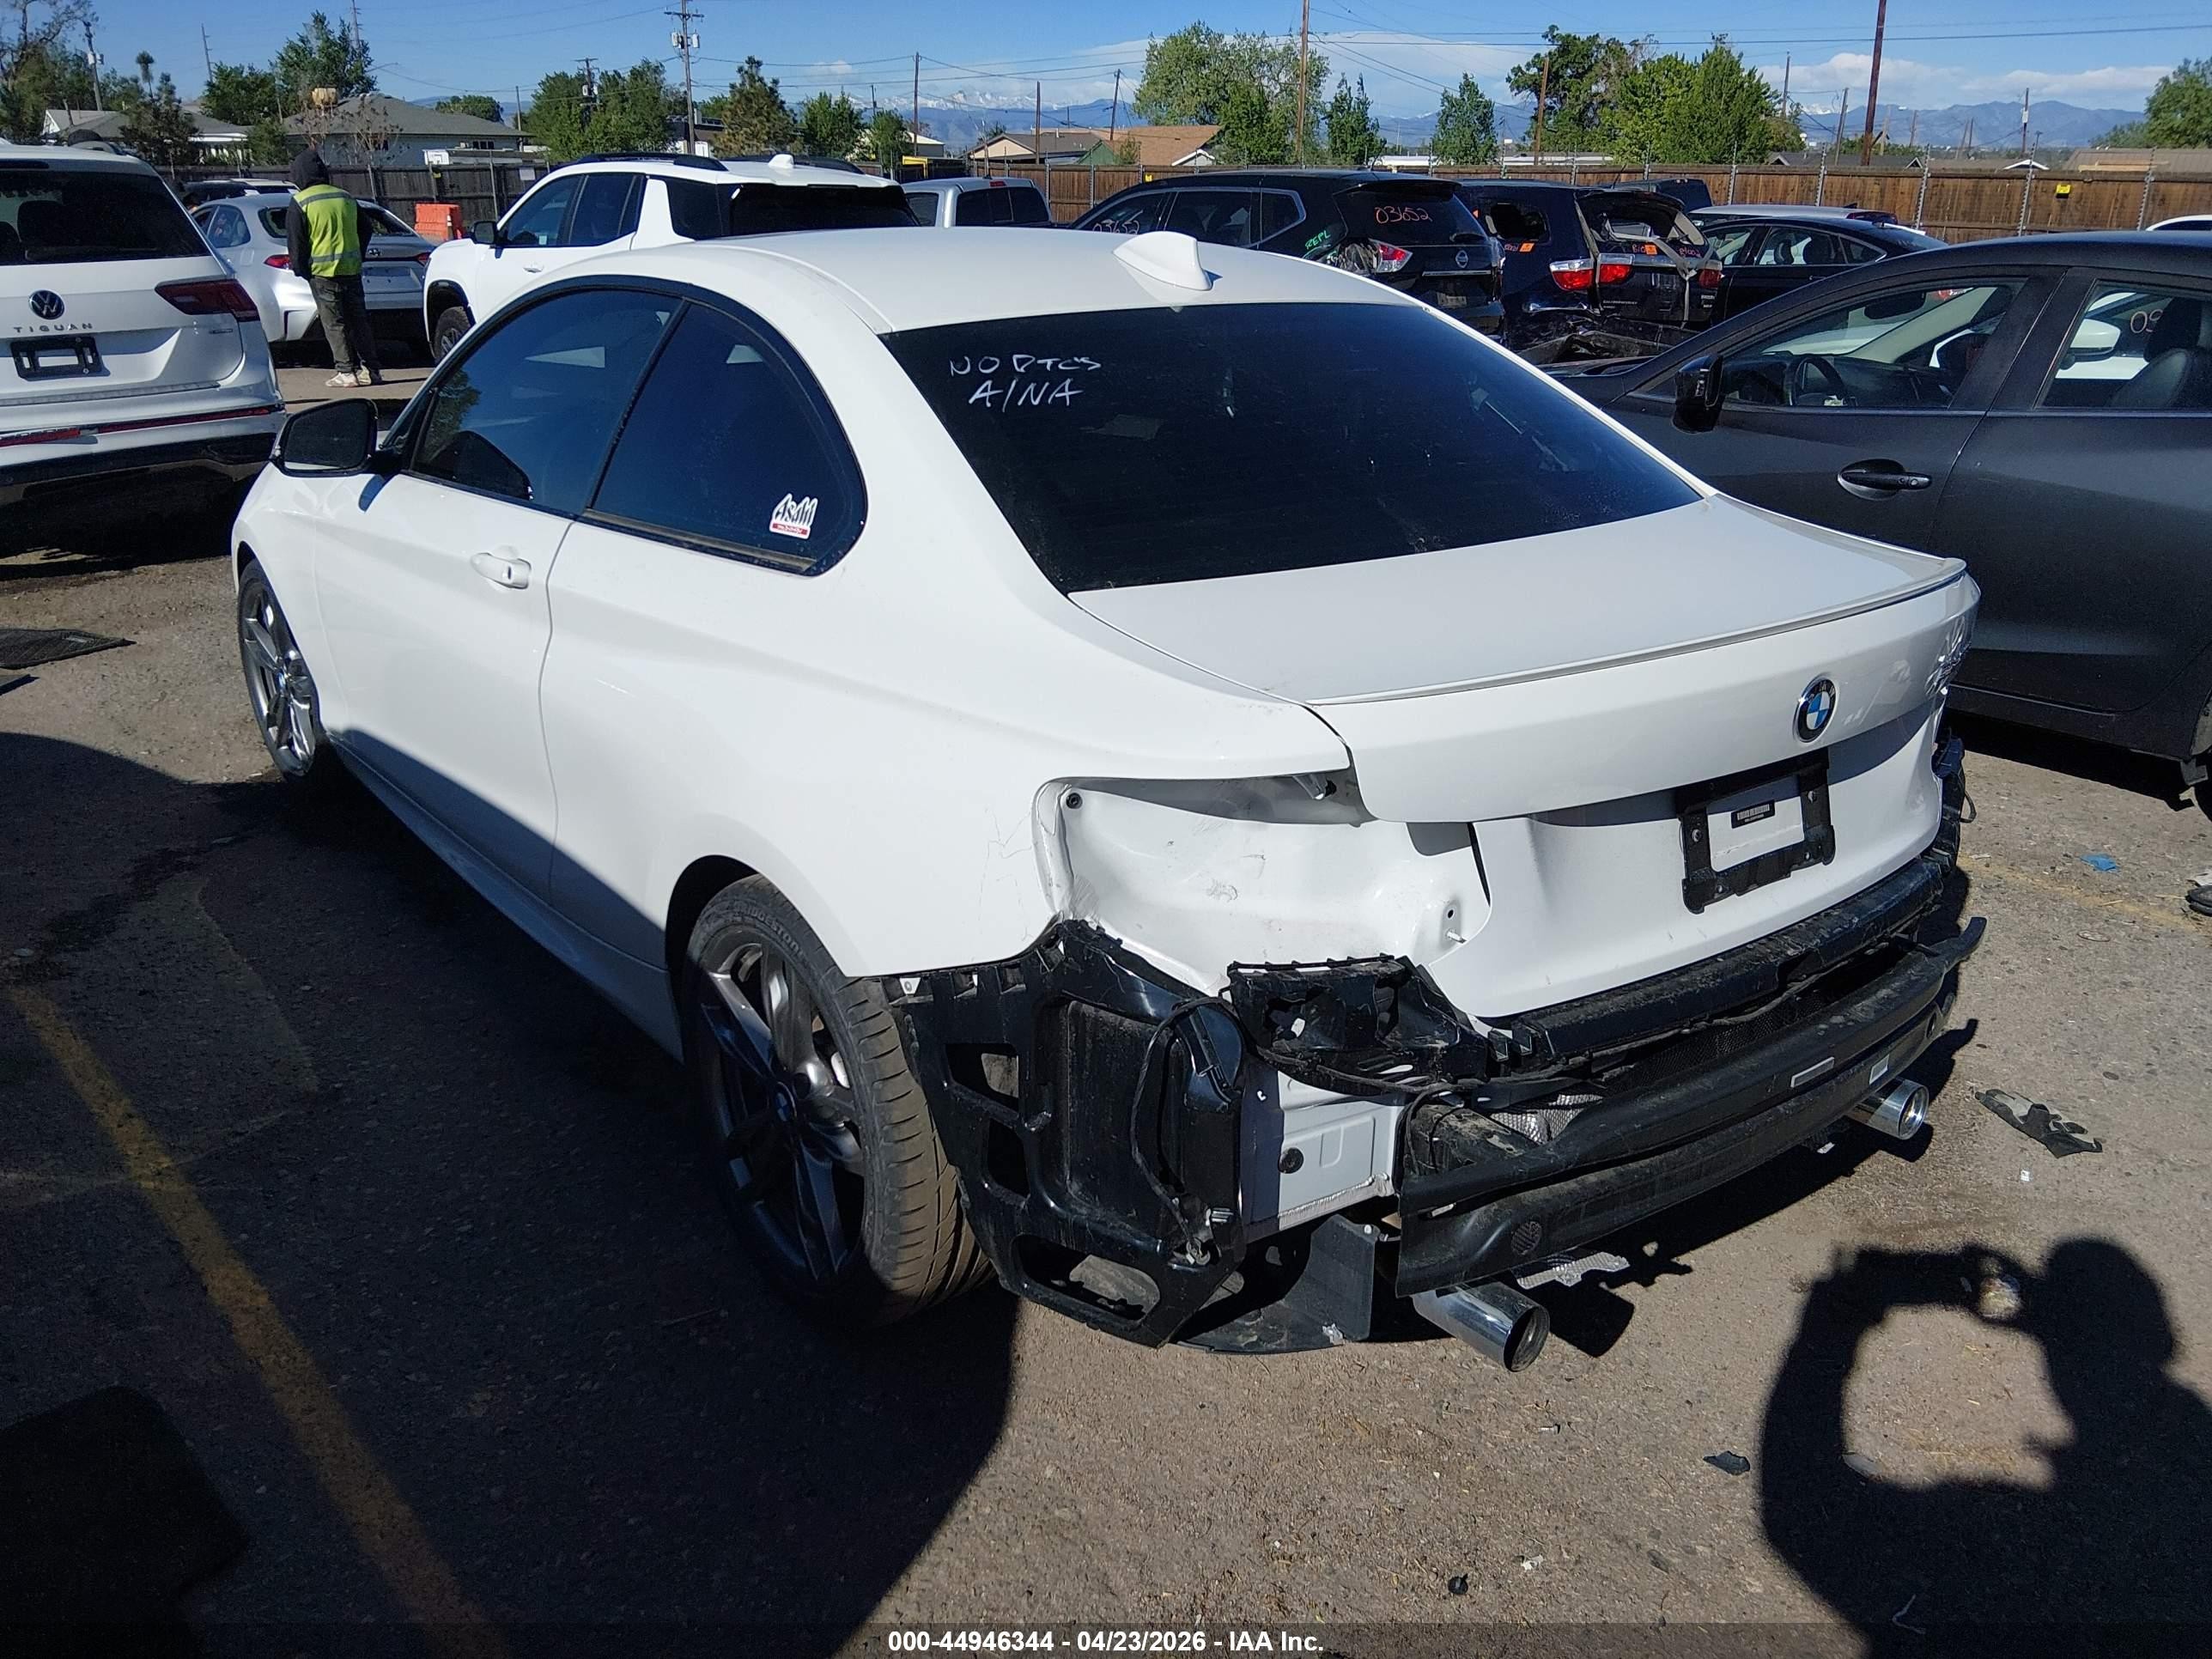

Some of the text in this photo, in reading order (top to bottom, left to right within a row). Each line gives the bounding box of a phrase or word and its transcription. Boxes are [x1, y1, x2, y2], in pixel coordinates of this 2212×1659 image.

[1375, 205, 1433, 224] 03652
[13, 322, 93, 333] TIGUAN
[950, 356, 1000, 376] NO
